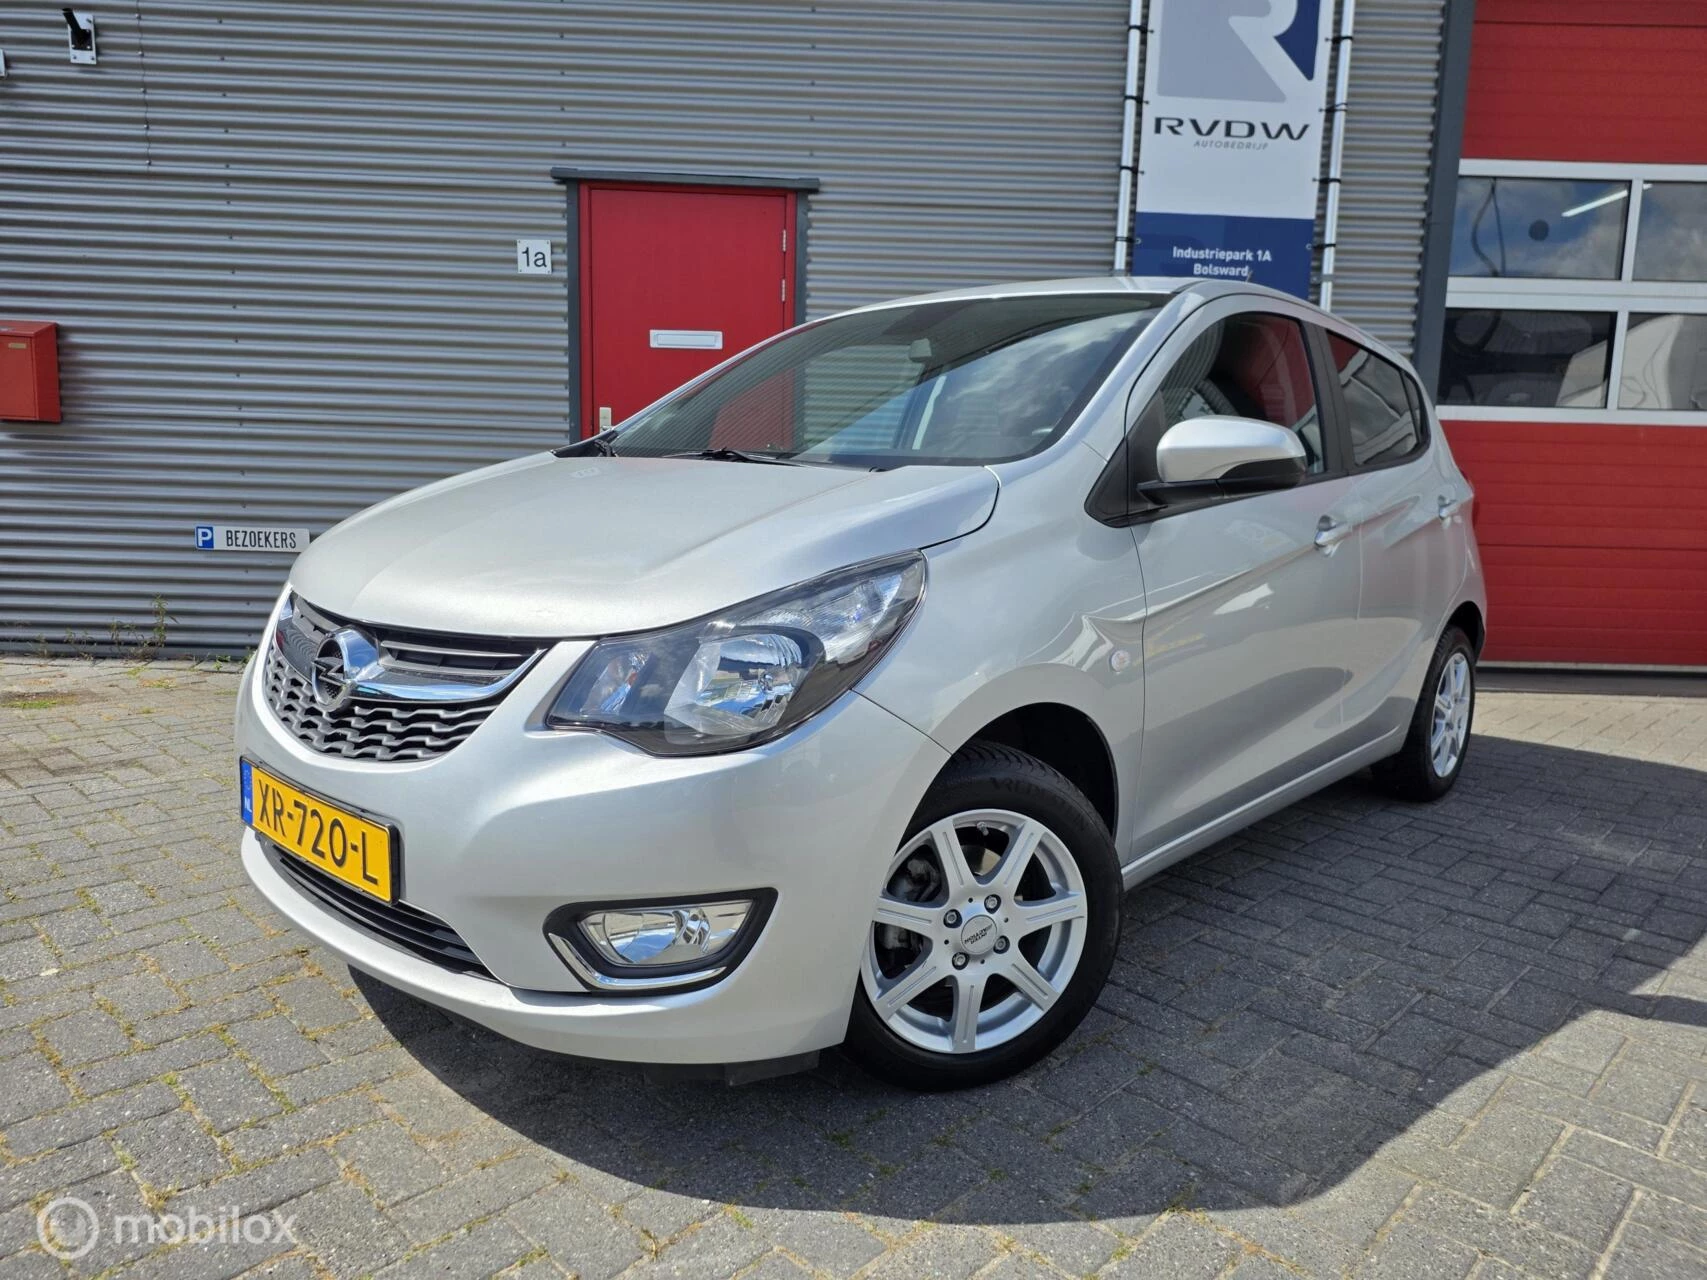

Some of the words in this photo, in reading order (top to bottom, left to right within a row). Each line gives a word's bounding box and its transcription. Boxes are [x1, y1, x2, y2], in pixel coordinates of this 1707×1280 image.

[1154, 116, 1310, 141] RVDW
[1193, 139, 1269, 150] AUTOBEDRIJF
[522, 247, 547, 267] 1a
[1172, 246, 1254, 262] Industriepark
[1256, 249, 1272, 262] 1A
[1193, 263, 1249, 277] Bolsward
[197, 528, 212, 547] P
[226, 530, 297, 549] BEZOEKERS
[244, 795, 253, 813] NL
[258, 779, 379, 886] XR-720-L
